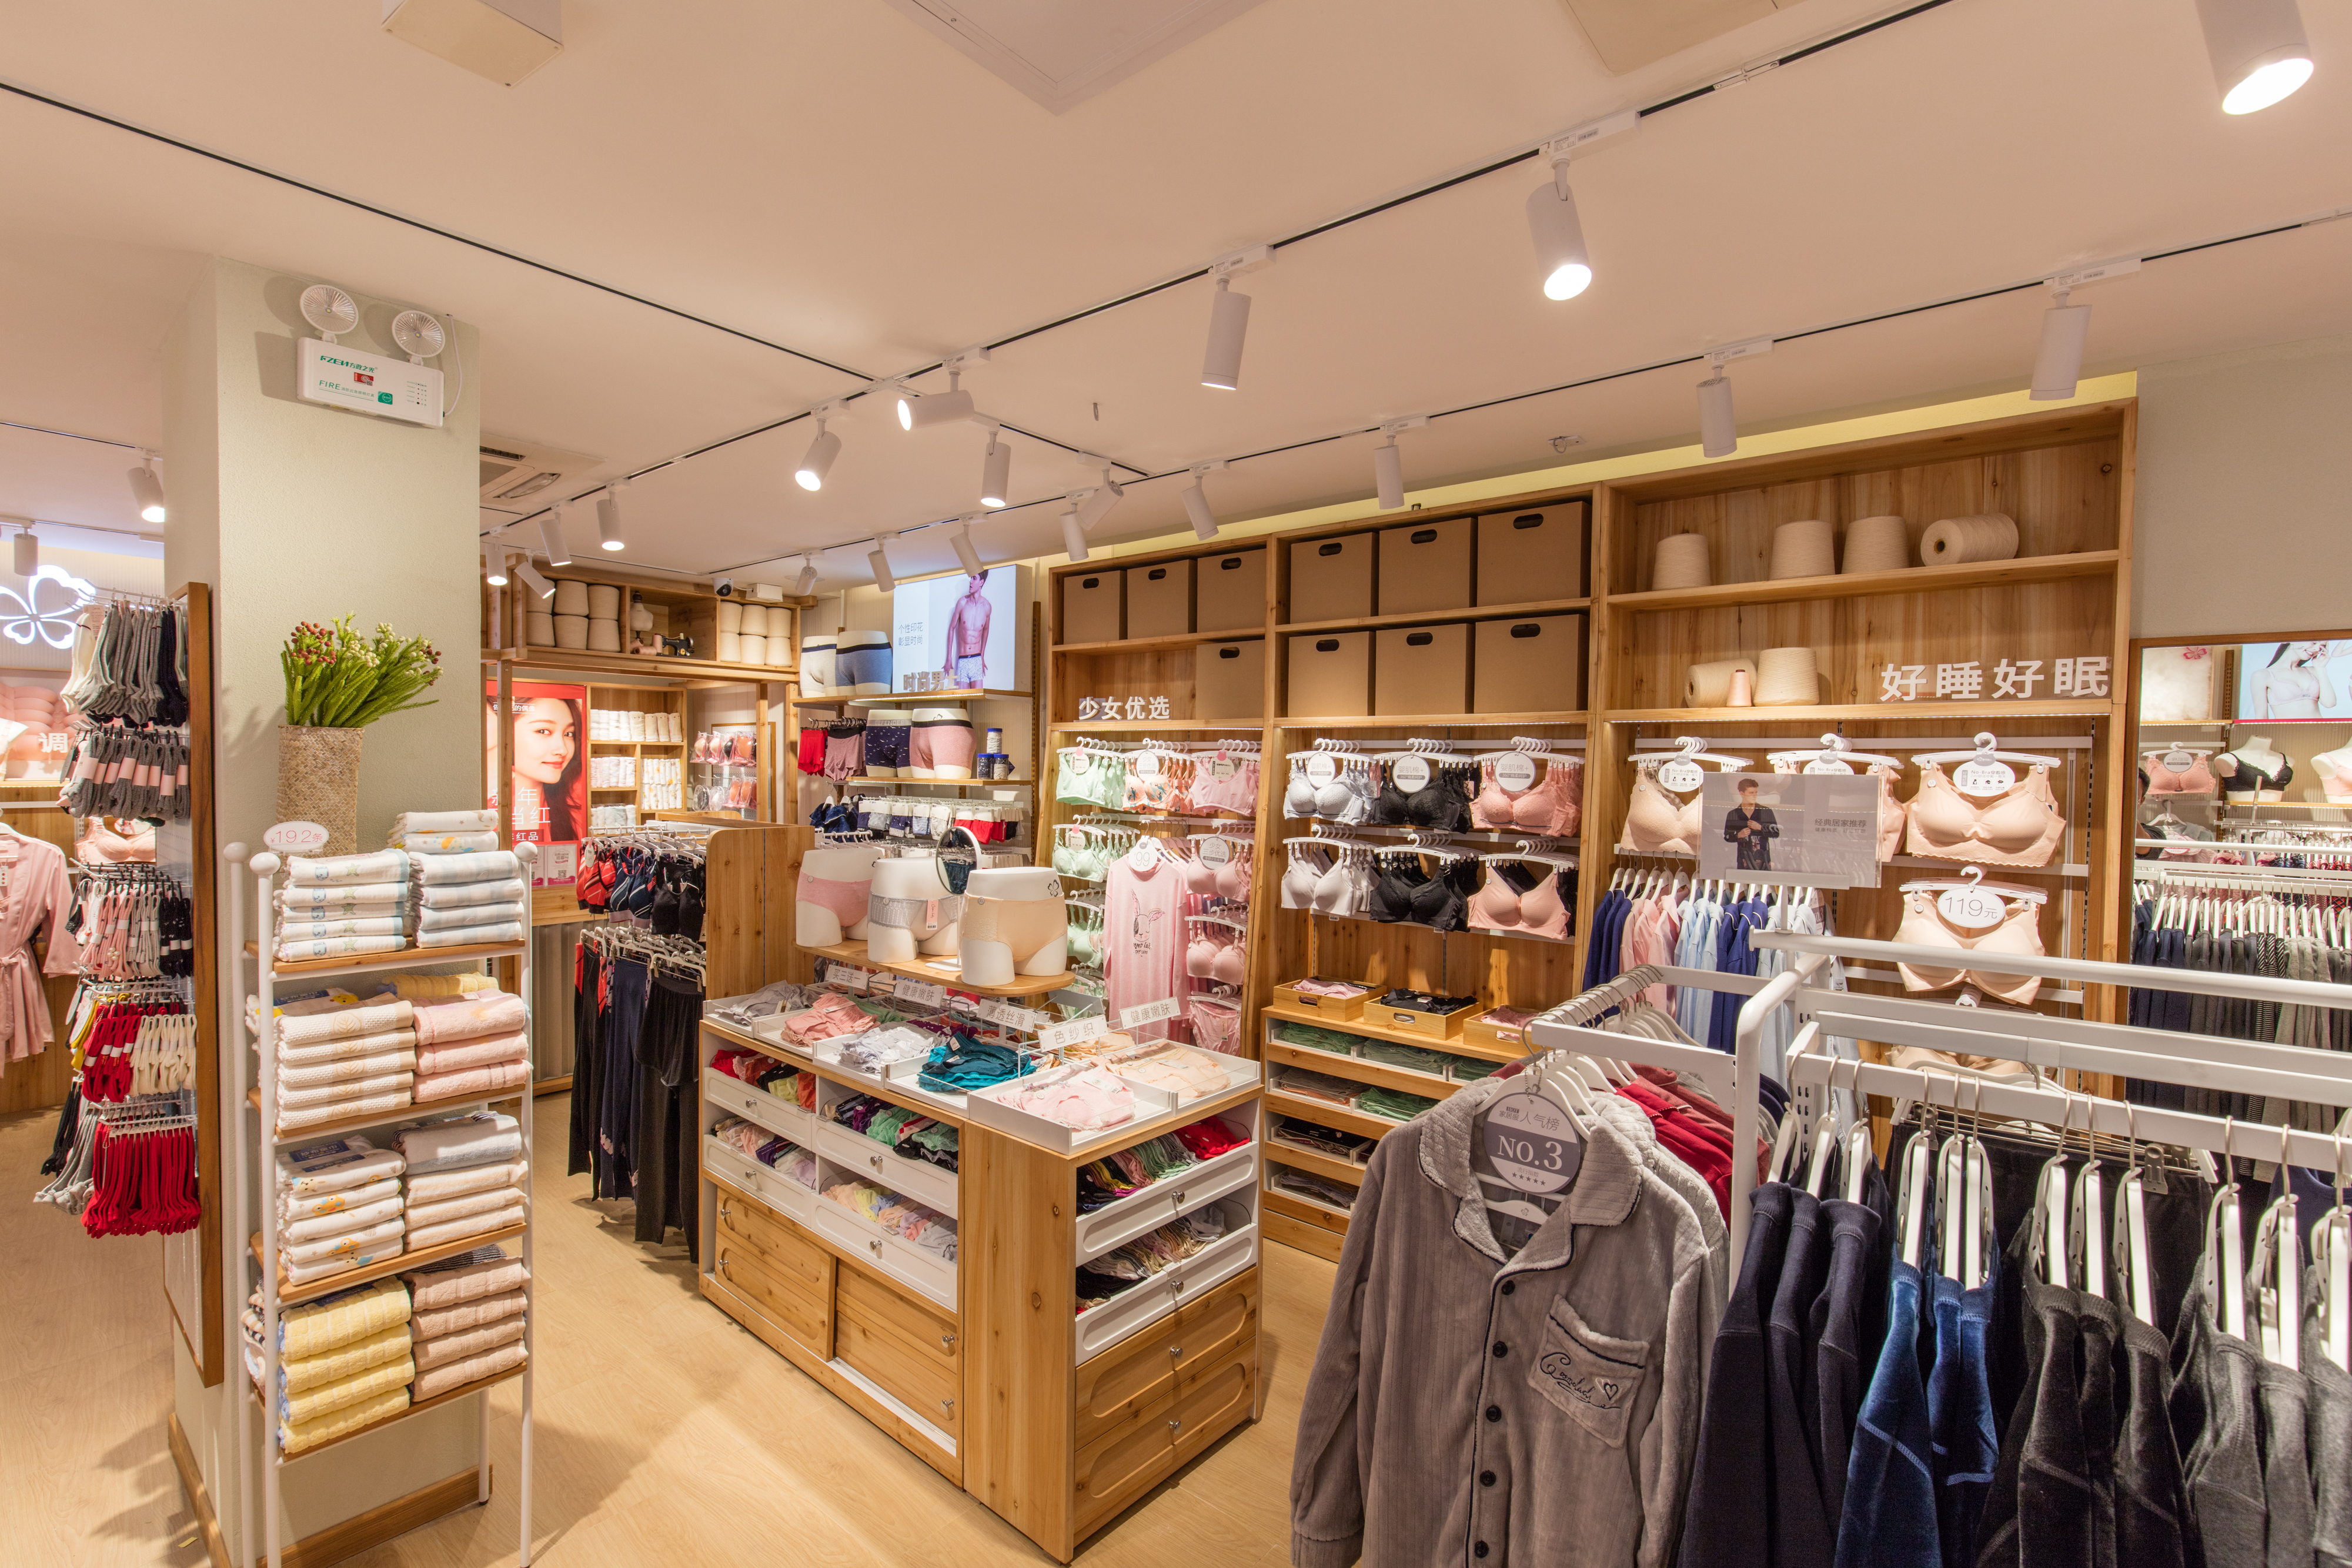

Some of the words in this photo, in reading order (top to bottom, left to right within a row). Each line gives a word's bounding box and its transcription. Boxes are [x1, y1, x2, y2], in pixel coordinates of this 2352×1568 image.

[319, 380, 341, 390] FIRE
[898, 621, 923, 634] 个性印花
[898, 634, 923, 646] 彰显时尚
[903, 669, 960, 692] 时尚男士
[1880, 656, 2109, 702] 好睡好眠
[493, 704, 536, 712] 做的偶像
[1079, 696, 1170, 720] 少女优选
[1501, 764, 1529, 772] 婴肌棉+
[1815, 818, 1867, 828] 经典居家推荐
[1202, 848, 1227, 858] 三步优选
[1945, 897, 1997, 919] 119元
[833, 968, 861, 983] 买三送一
[903, 984, 935, 1002] 健康嫩肤
[986, 1005, 1025, 1027] 薄透丝滑
[1130, 1002, 1170, 1024] 健康嫩肤
[1054, 1022, 1094, 1044] 色纱织
[1499, 1110, 1519, 1121] 家居服
[1519, 1111, 1560, 1131] 人气榜
[1498, 1135, 1562, 1170] NO.3
[1517, 1166, 1539, 1178] 流行指数
